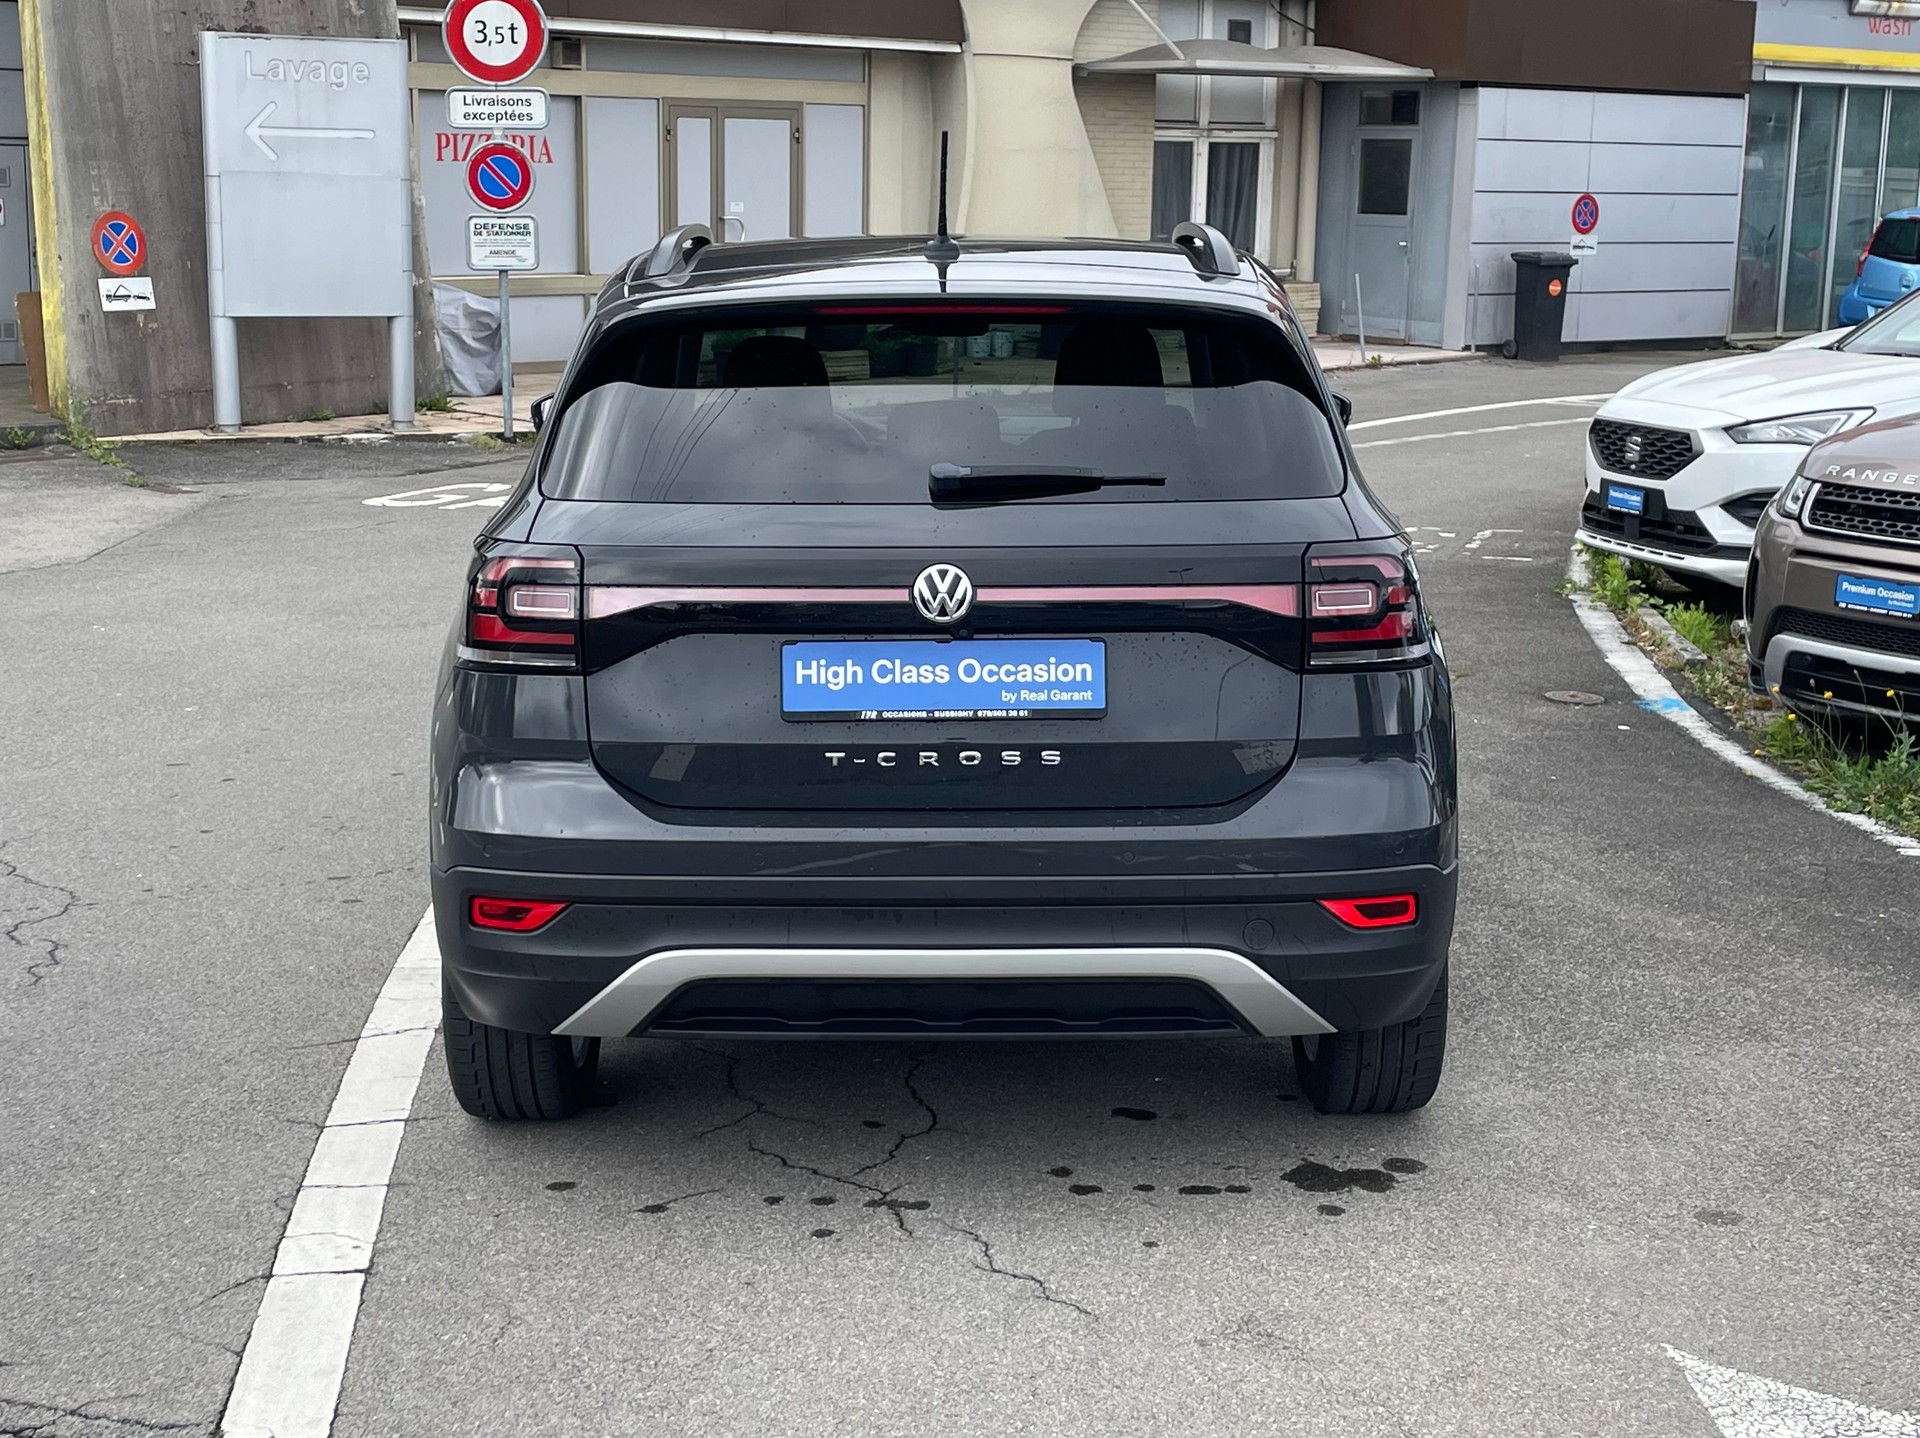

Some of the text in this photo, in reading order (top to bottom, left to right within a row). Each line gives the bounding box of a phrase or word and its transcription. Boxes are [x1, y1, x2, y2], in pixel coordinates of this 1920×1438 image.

[244, 50, 371, 91] Lavage
[463, 95, 532, 107] Livraisons
[463, 110, 534, 123] exceptées
[435, 132, 554, 164] PIZIA
[1825, 464, 1920, 485] RANGE
[796, 656, 1093, 691] High Class Occasion
[1001, 689, 1093, 704] by Real Garant
[824, 751, 1062, 767] T-CROSS
